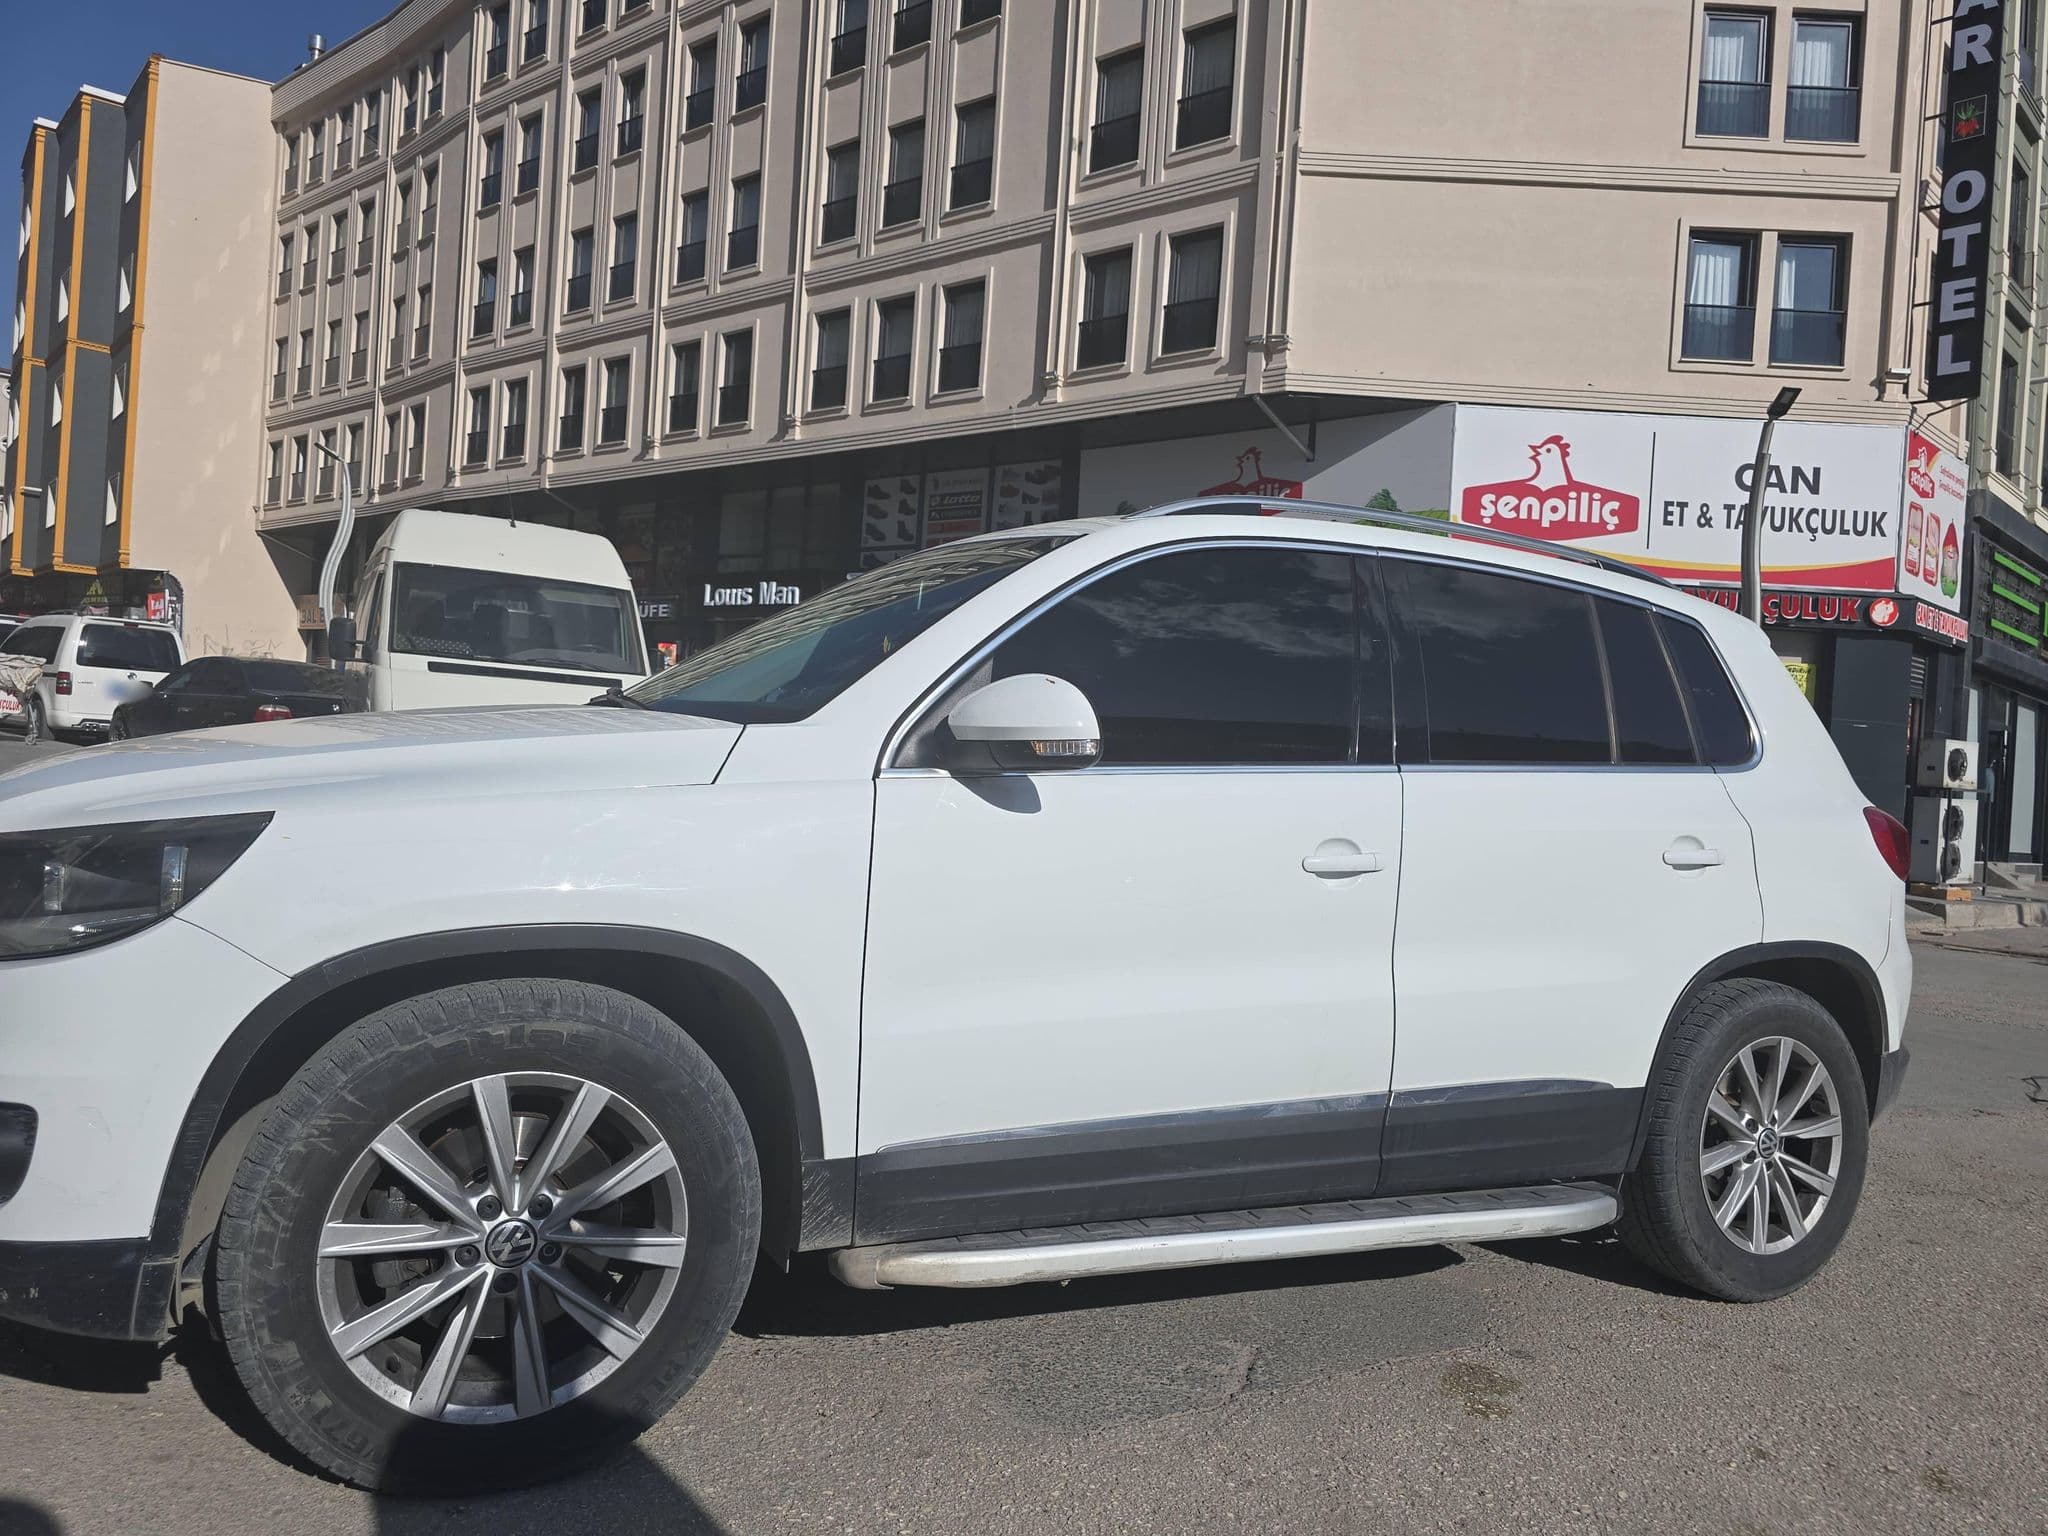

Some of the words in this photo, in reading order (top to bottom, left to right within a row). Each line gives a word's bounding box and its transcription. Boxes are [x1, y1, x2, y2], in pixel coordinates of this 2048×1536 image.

[1936, 169, 1986, 377] OTEL
[1735, 463, 1821, 495] CAN
[1662, 500, 1689, 527] ET
[1696, 502, 1714, 528] &
[703, 583, 753, 606] Louis
[759, 581, 800, 605] Man
